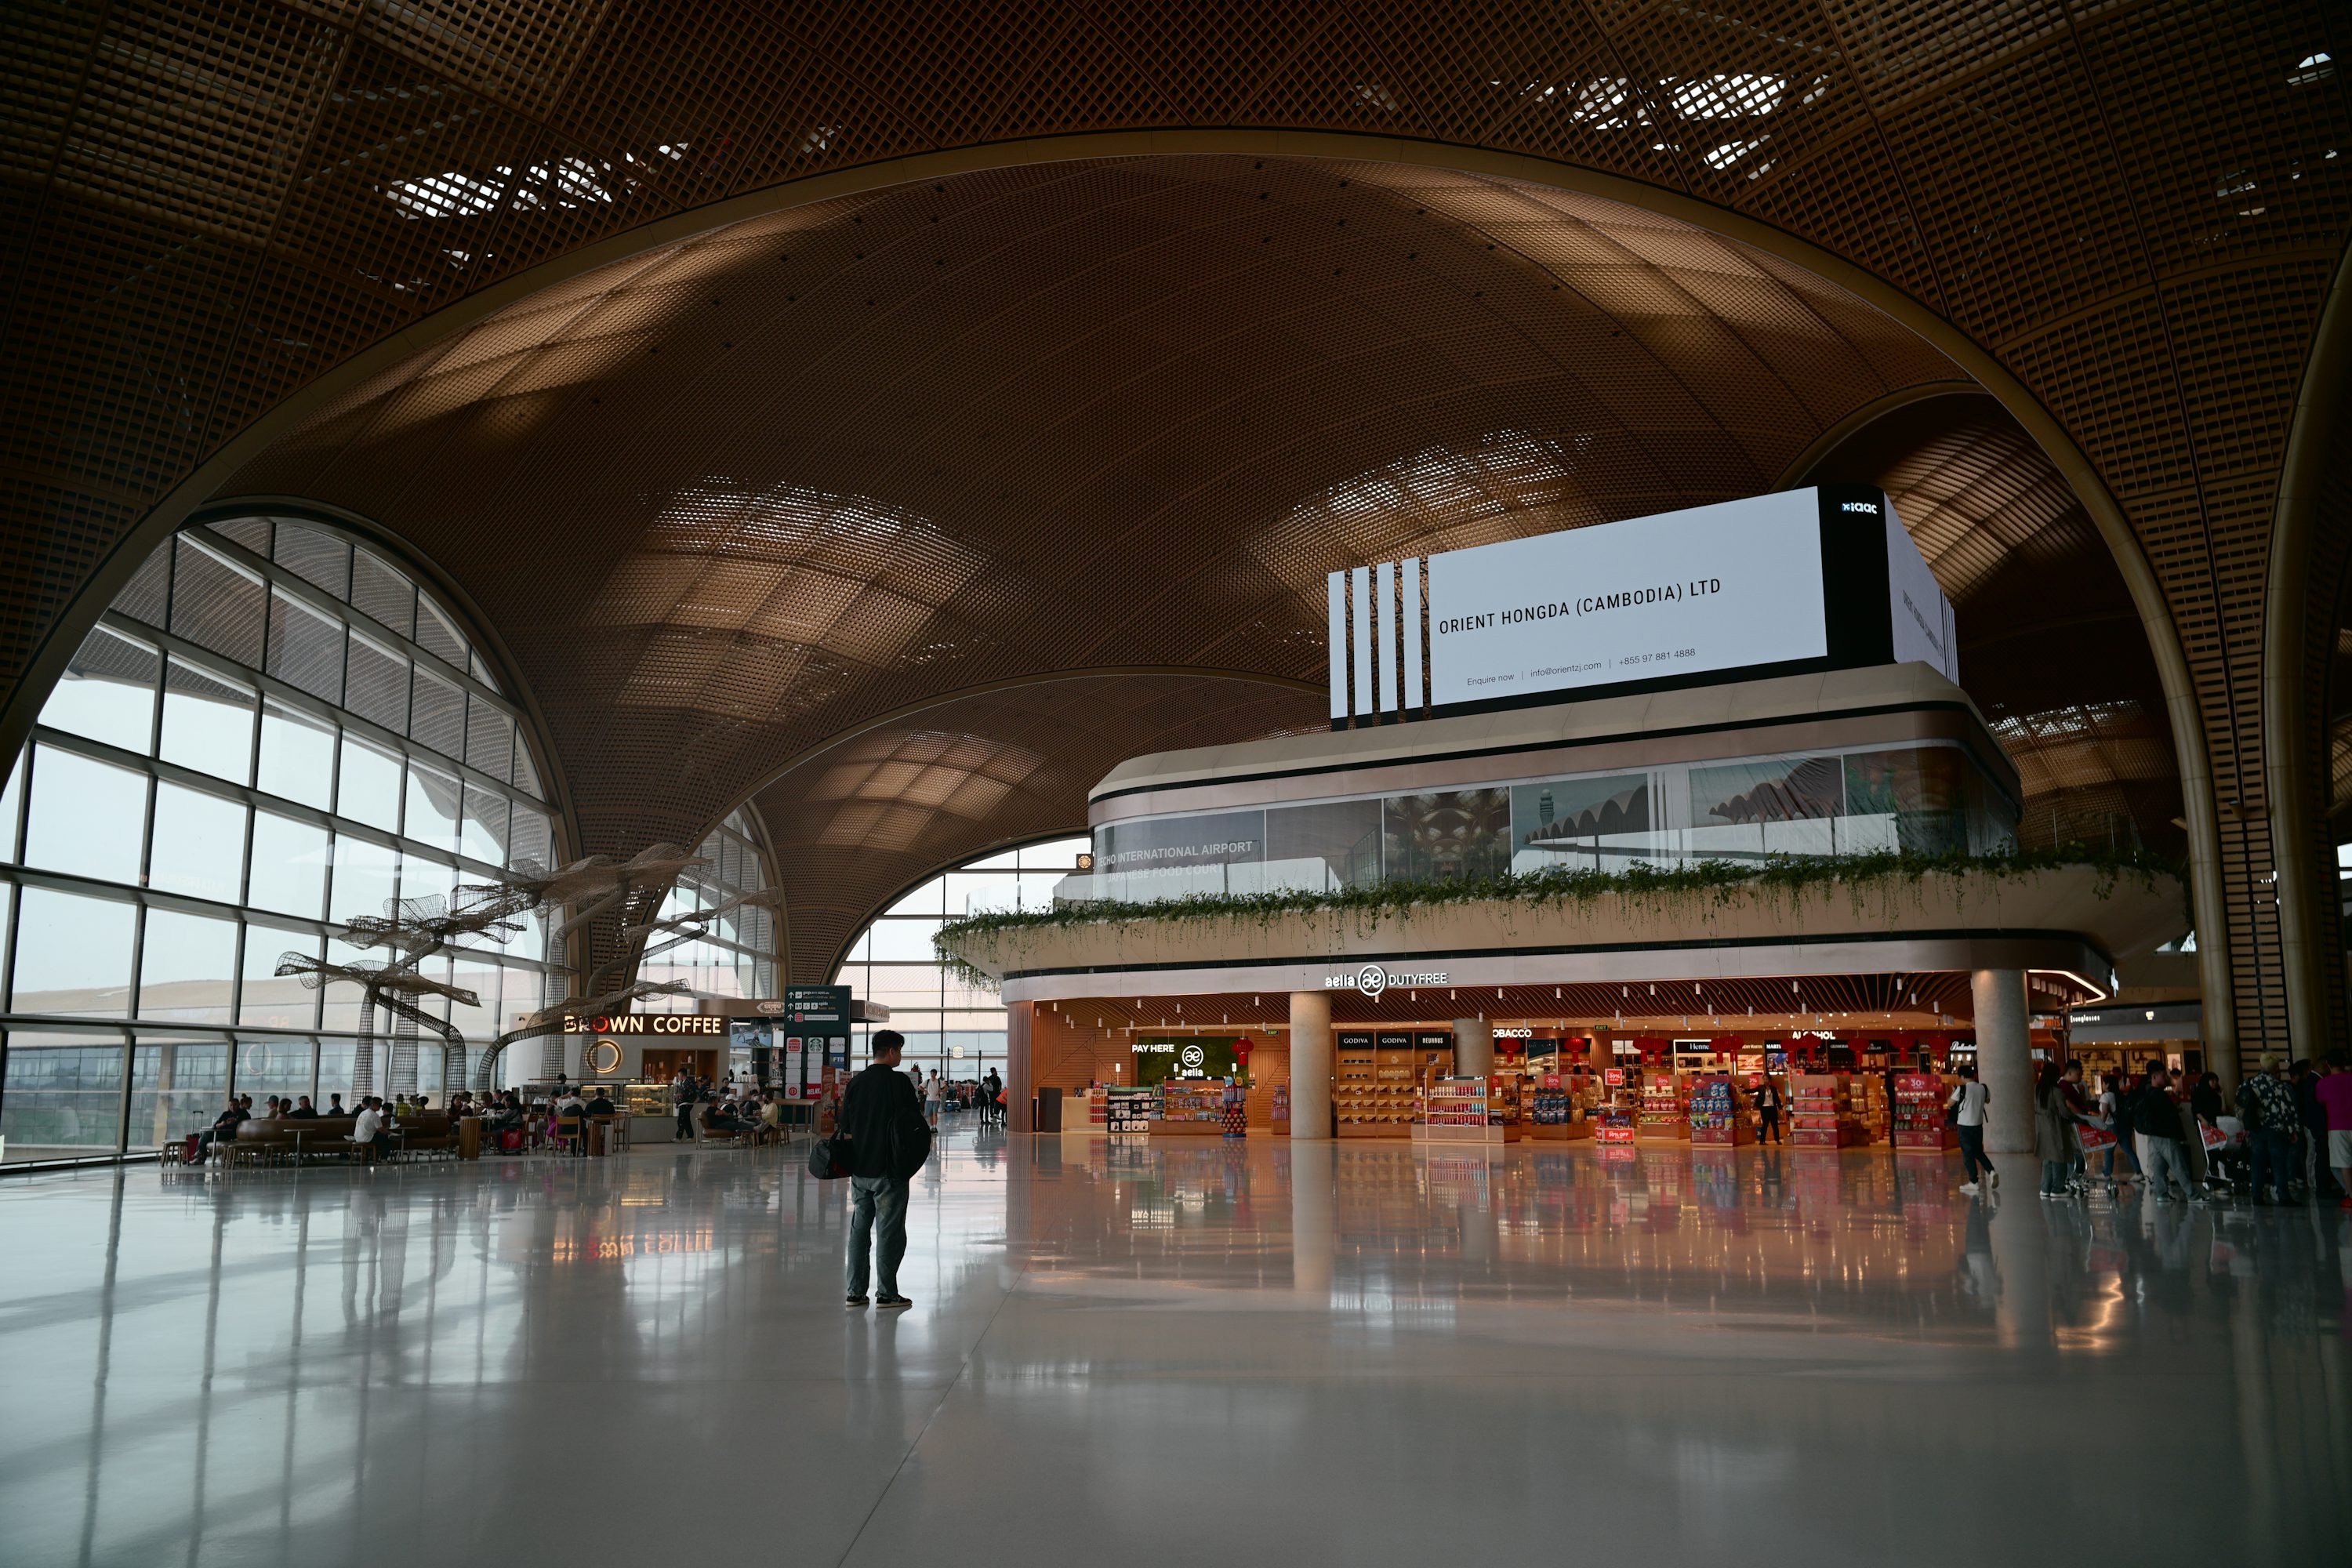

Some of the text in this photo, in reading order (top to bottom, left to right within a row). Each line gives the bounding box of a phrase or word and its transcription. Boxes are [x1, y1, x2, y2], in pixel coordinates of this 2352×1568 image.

[1439, 578, 1721, 634] ORIENT HONGDA (CAMBODIA) LTD
[1467, 648, 1696, 687] Enquire now info@orientzj.com +855 97 881 4888
[1097, 841, 1253, 868] TECHO INTERNATIONAL AIRPORT
[1107, 862, 1225, 883] JAPANESE FOOD COURT
[1325, 974, 1355, 987] aelia
[1388, 972, 1448, 985] DUTYFREE
[653, 1017, 720, 1033] COFFEE
[1492, 1029, 1532, 1038] OBACCO
[1131, 1044, 1174, 1053] PAY HERE
[1181, 1068, 1203, 1077] aelia
